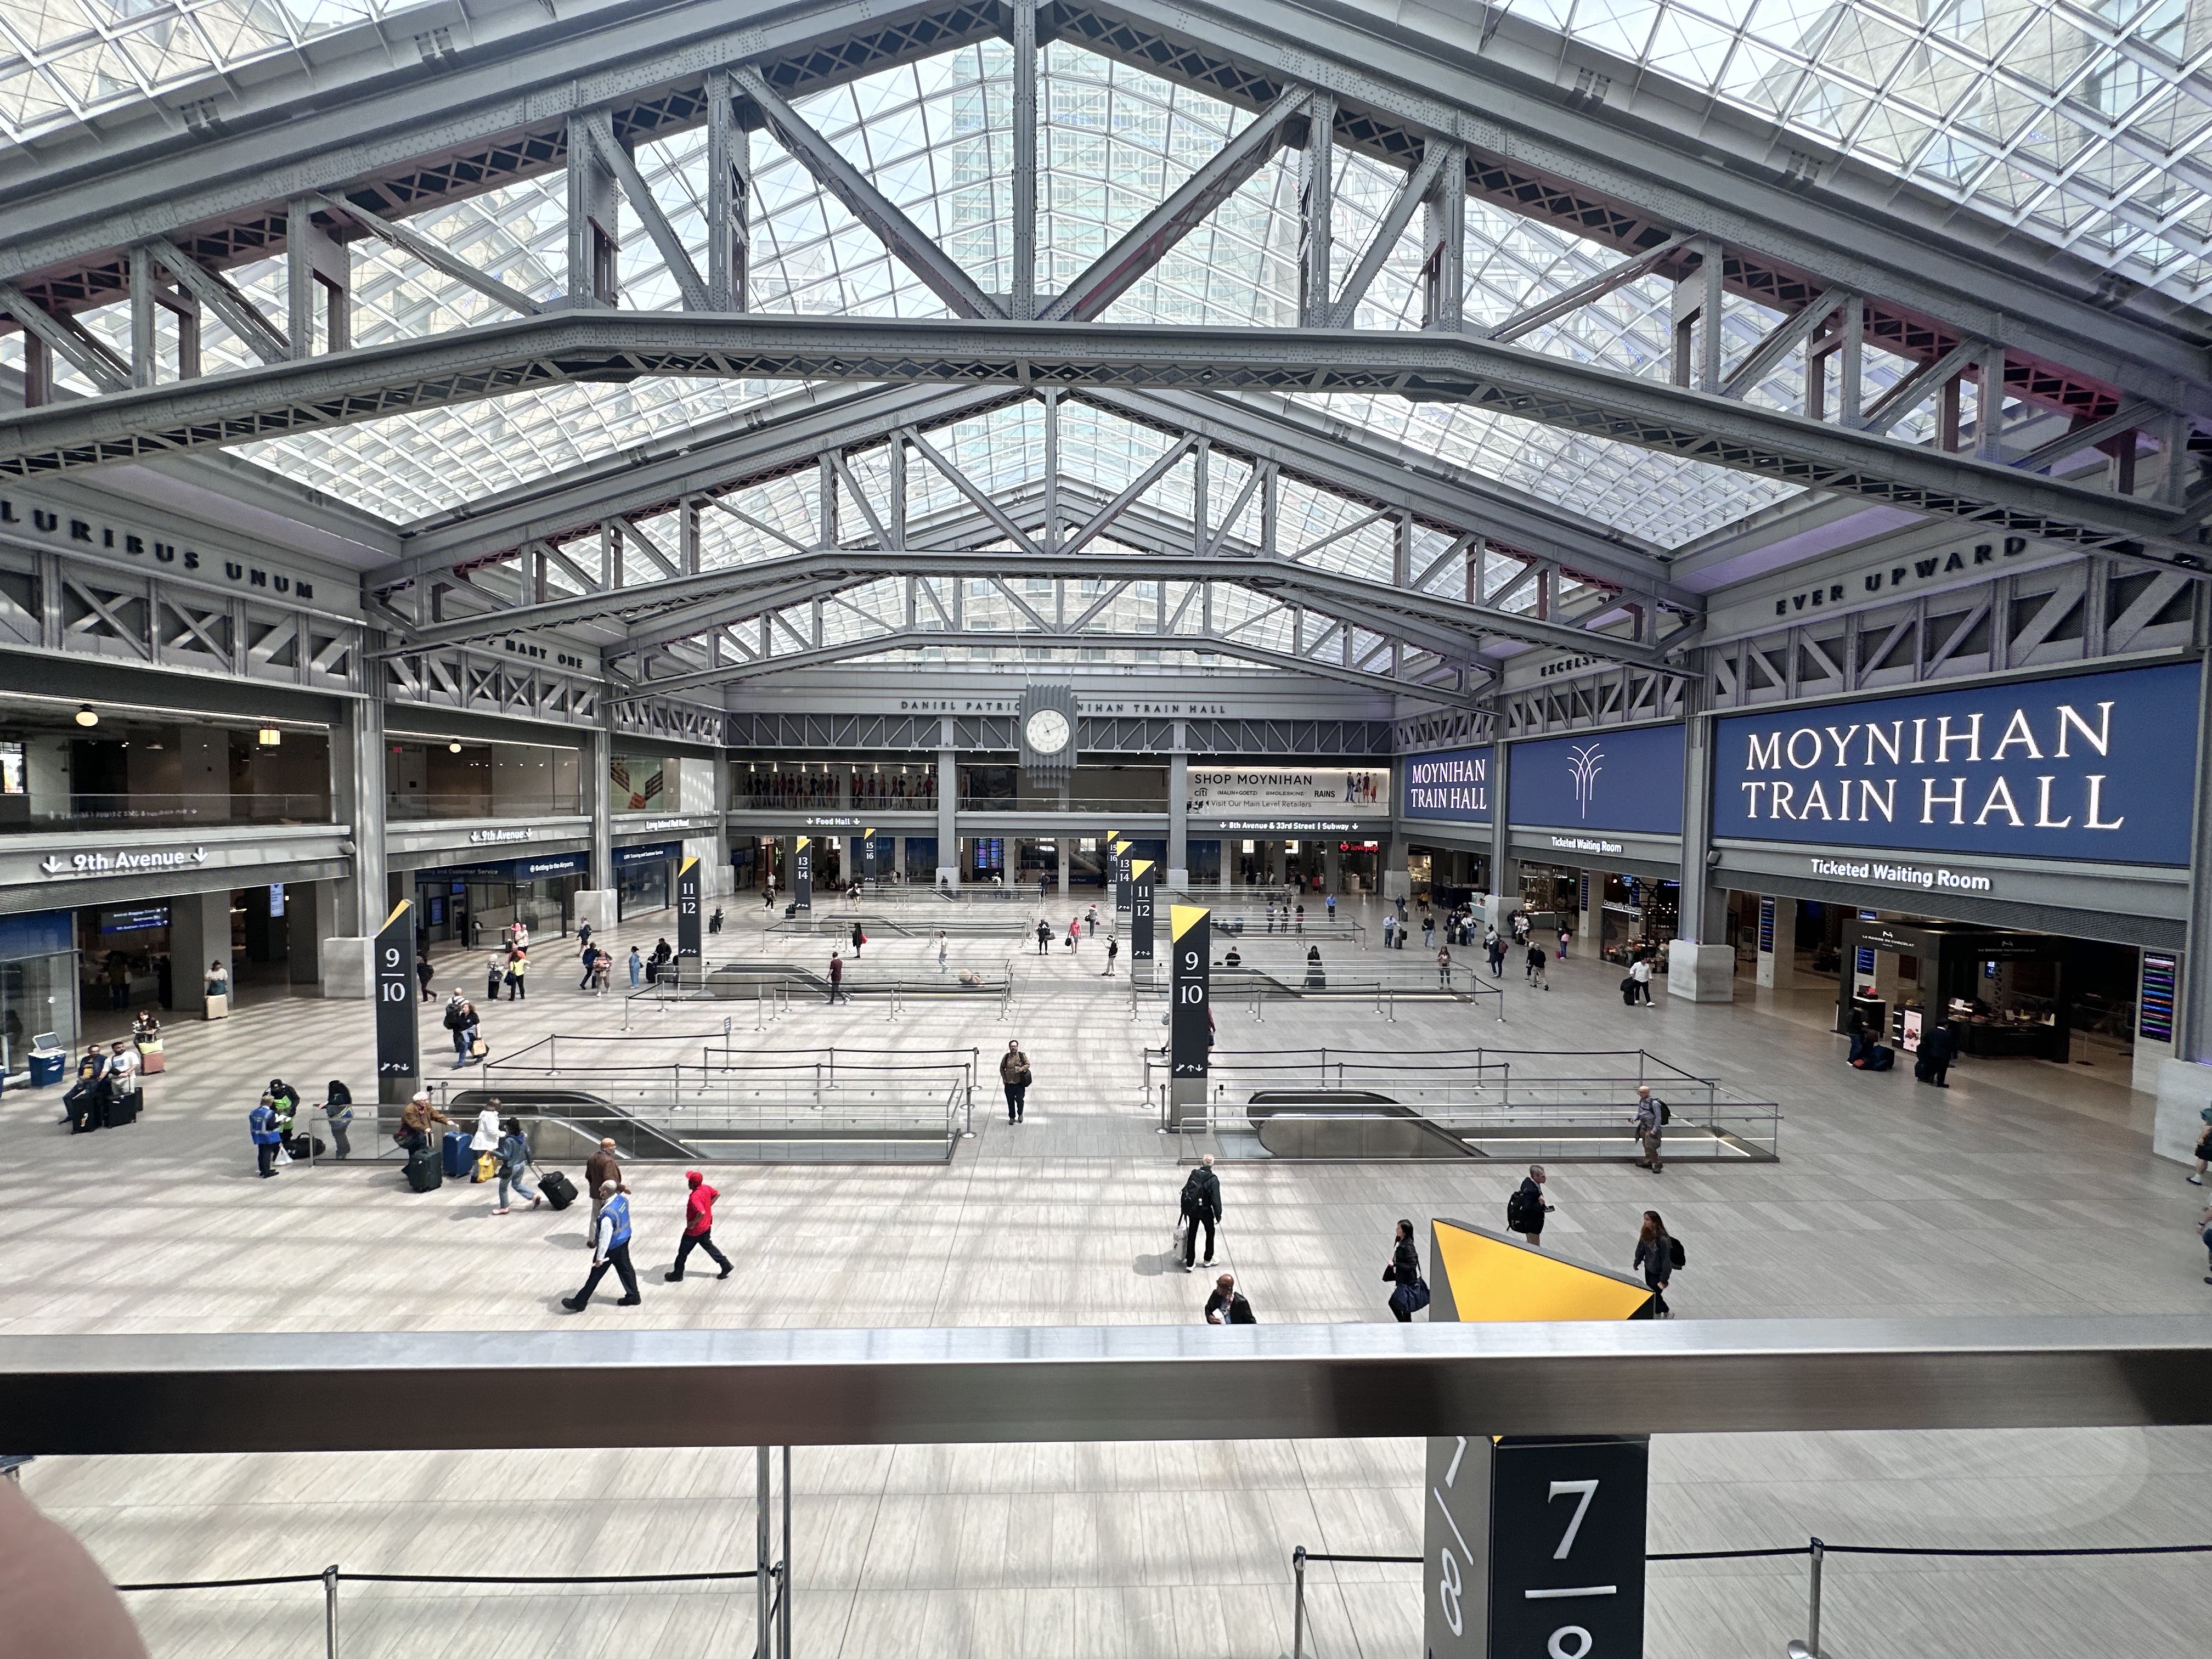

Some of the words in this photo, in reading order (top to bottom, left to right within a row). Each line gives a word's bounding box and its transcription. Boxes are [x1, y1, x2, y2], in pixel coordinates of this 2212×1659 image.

[1, 500, 199, 569] LURIBUS
[225, 562, 313, 599] UNUM
[1775, 585, 1844, 616] EVER
[1865, 537, 2027, 591] UPWARD
[557, 653, 583, 669] ONE
[1540, 656, 1596, 677] EXCELS
[901, 701, 956, 710] DANIEL
[966, 702, 1020, 710] PATRIC
[1077, 703, 1124, 712] NIHAN
[1133, 704, 1180, 713] TRAIN
[1189, 705, 1225, 714] HALL
[1745, 701, 2115, 770] MOYNIHAN
[1412, 759, 1486, 784] MOYNIHAN
[1194, 774, 1232, 785] SHOP
[1237, 774, 1313, 786] MOYNIHAN
[1194, 788, 1209, 797] citi
[1314, 790, 1336, 798] RAINS
[1410, 788, 1447, 808] TRAIN
[1450, 787, 1487, 810] HALL
[1741, 778, 1898, 823] TRAIN
[1918, 774, 2125, 831] HALL
[646, 821, 657, 831] Long
[481, 830, 495, 841] 9th
[497, 829, 524, 840] Avenue
[1350, 844, 1379, 853] lovepop
[1551, 836, 1576, 849] Ticketed
[1577, 838, 1601, 853] Waiting
[1601, 840, 1622, 853] Room
[74, 853, 109, 872] 9th
[115, 851, 184, 868] Avenue
[798, 856, 808, 866] 13
[1120, 859, 1130, 868] 13
[798, 871, 808, 879] 14
[1120, 873, 1130, 882] 14
[1810, 858, 1869, 878] Ticketed
[1873, 864, 1933, 888] Waiting
[1937, 869, 1990, 891] Room
[682, 883, 694, 894] 11
[1138, 885, 1149, 897] 11
[682, 902, 696, 914] 12
[1137, 905, 1150, 916] 12
[385, 947, 400, 968] 9
[1185, 951, 1199, 971] 9
[382, 982, 406, 1002] 10
[1180, 985, 1203, 1005] 10
[1547, 1479, 1600, 1560] 7
[1440, 1547, 1463, 1637] 8
